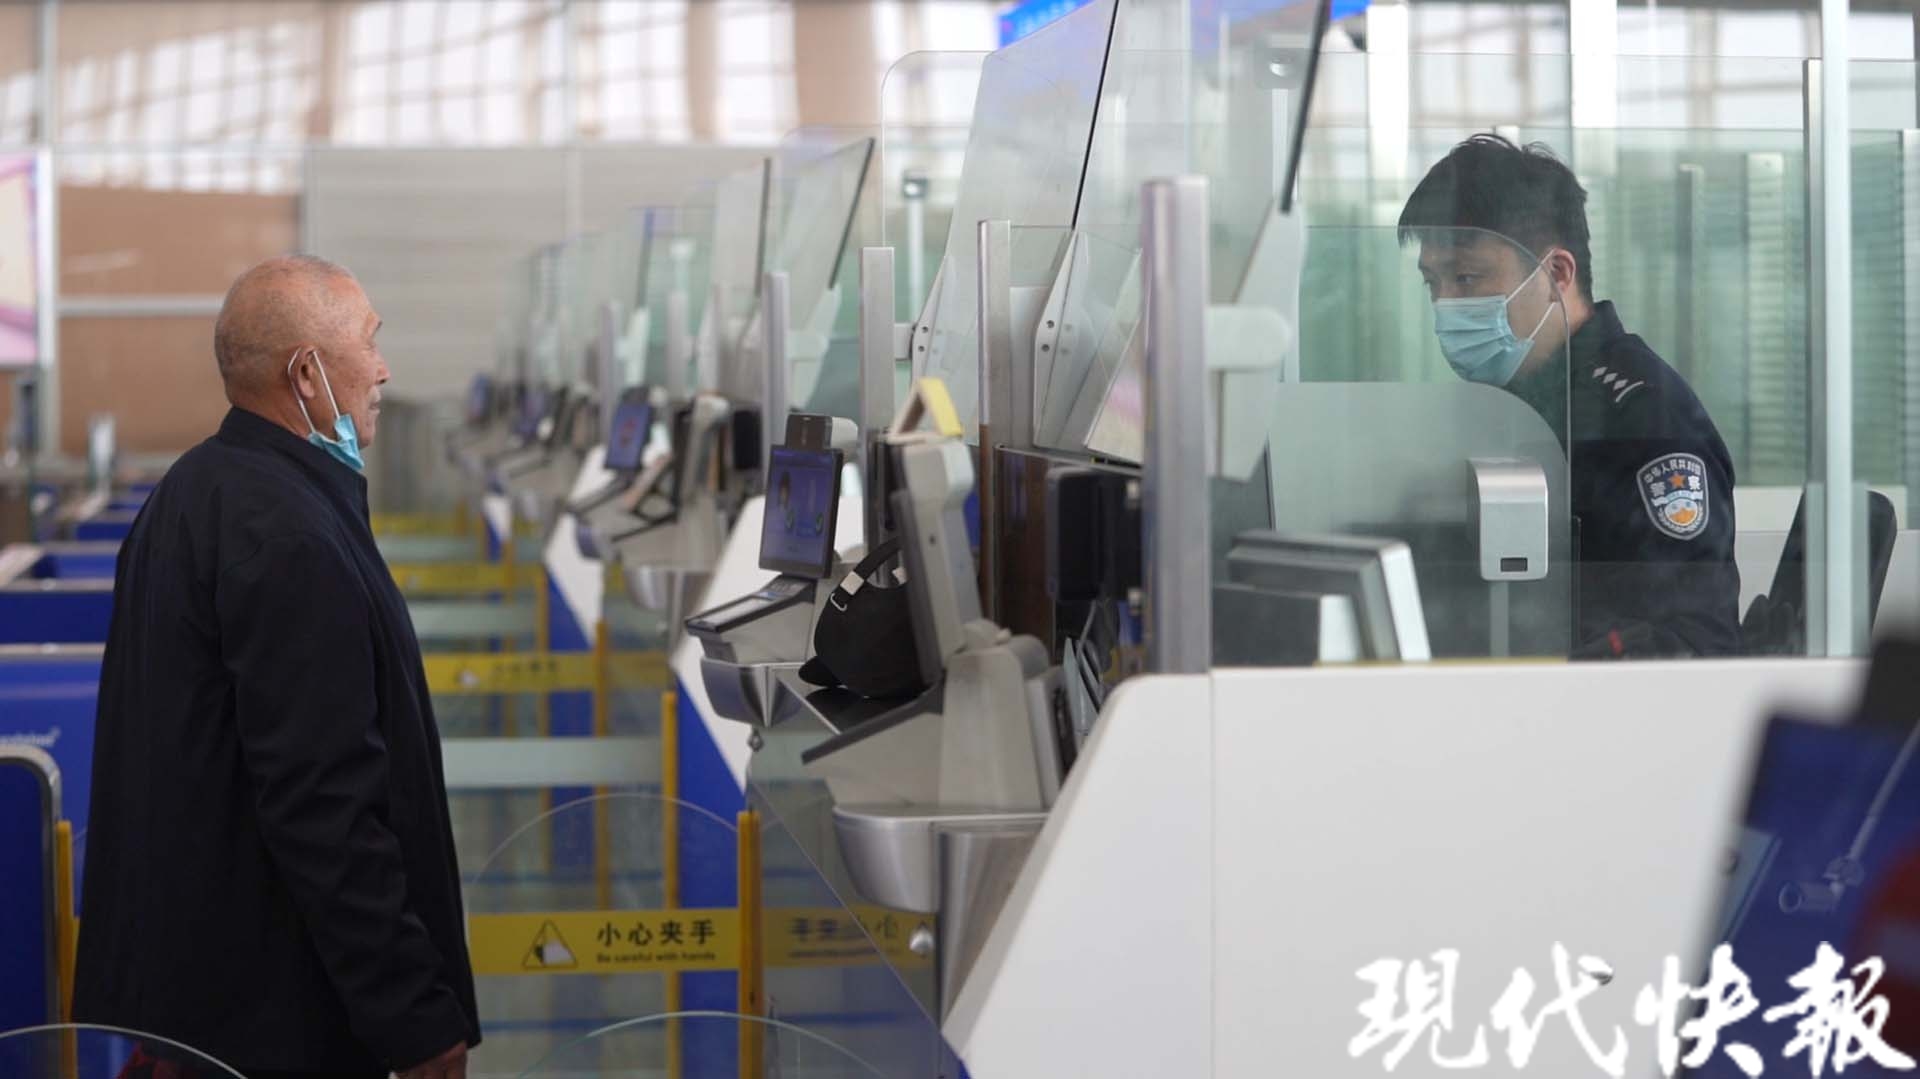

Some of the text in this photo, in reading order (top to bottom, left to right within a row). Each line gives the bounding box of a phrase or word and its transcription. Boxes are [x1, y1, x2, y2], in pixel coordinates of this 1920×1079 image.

[1643, 459, 1702, 483] 中华人民共和国
[597, 919, 716, 947] 小心夹手
